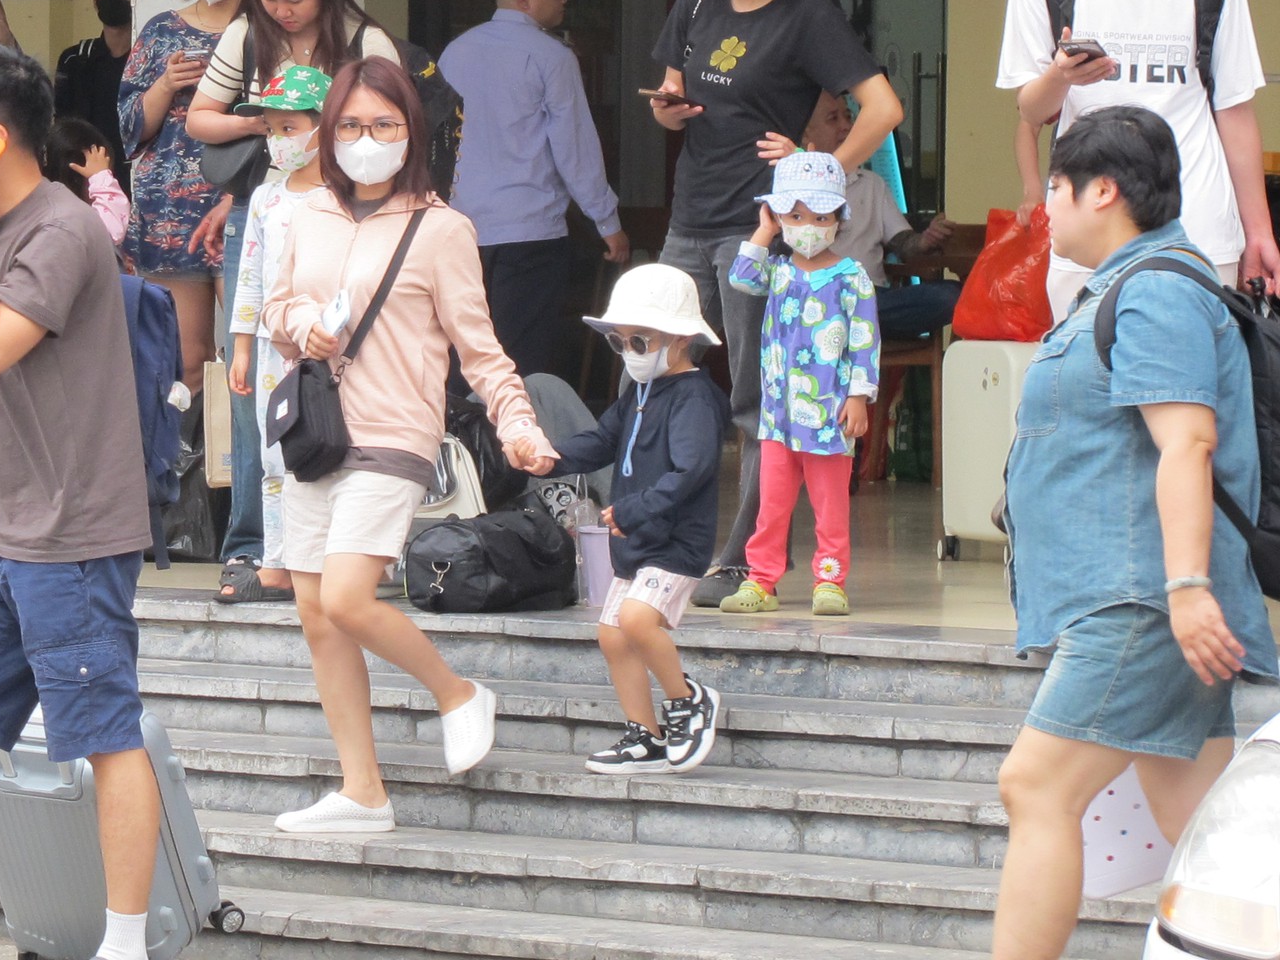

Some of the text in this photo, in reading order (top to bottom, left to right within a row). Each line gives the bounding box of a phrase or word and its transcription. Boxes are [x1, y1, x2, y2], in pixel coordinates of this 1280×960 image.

[1073, 30, 1192, 42] IGINAL SPORTWEAR DIVISION
[1103, 42, 1190, 85] STER
[701, 71, 733, 86] LUCKY
